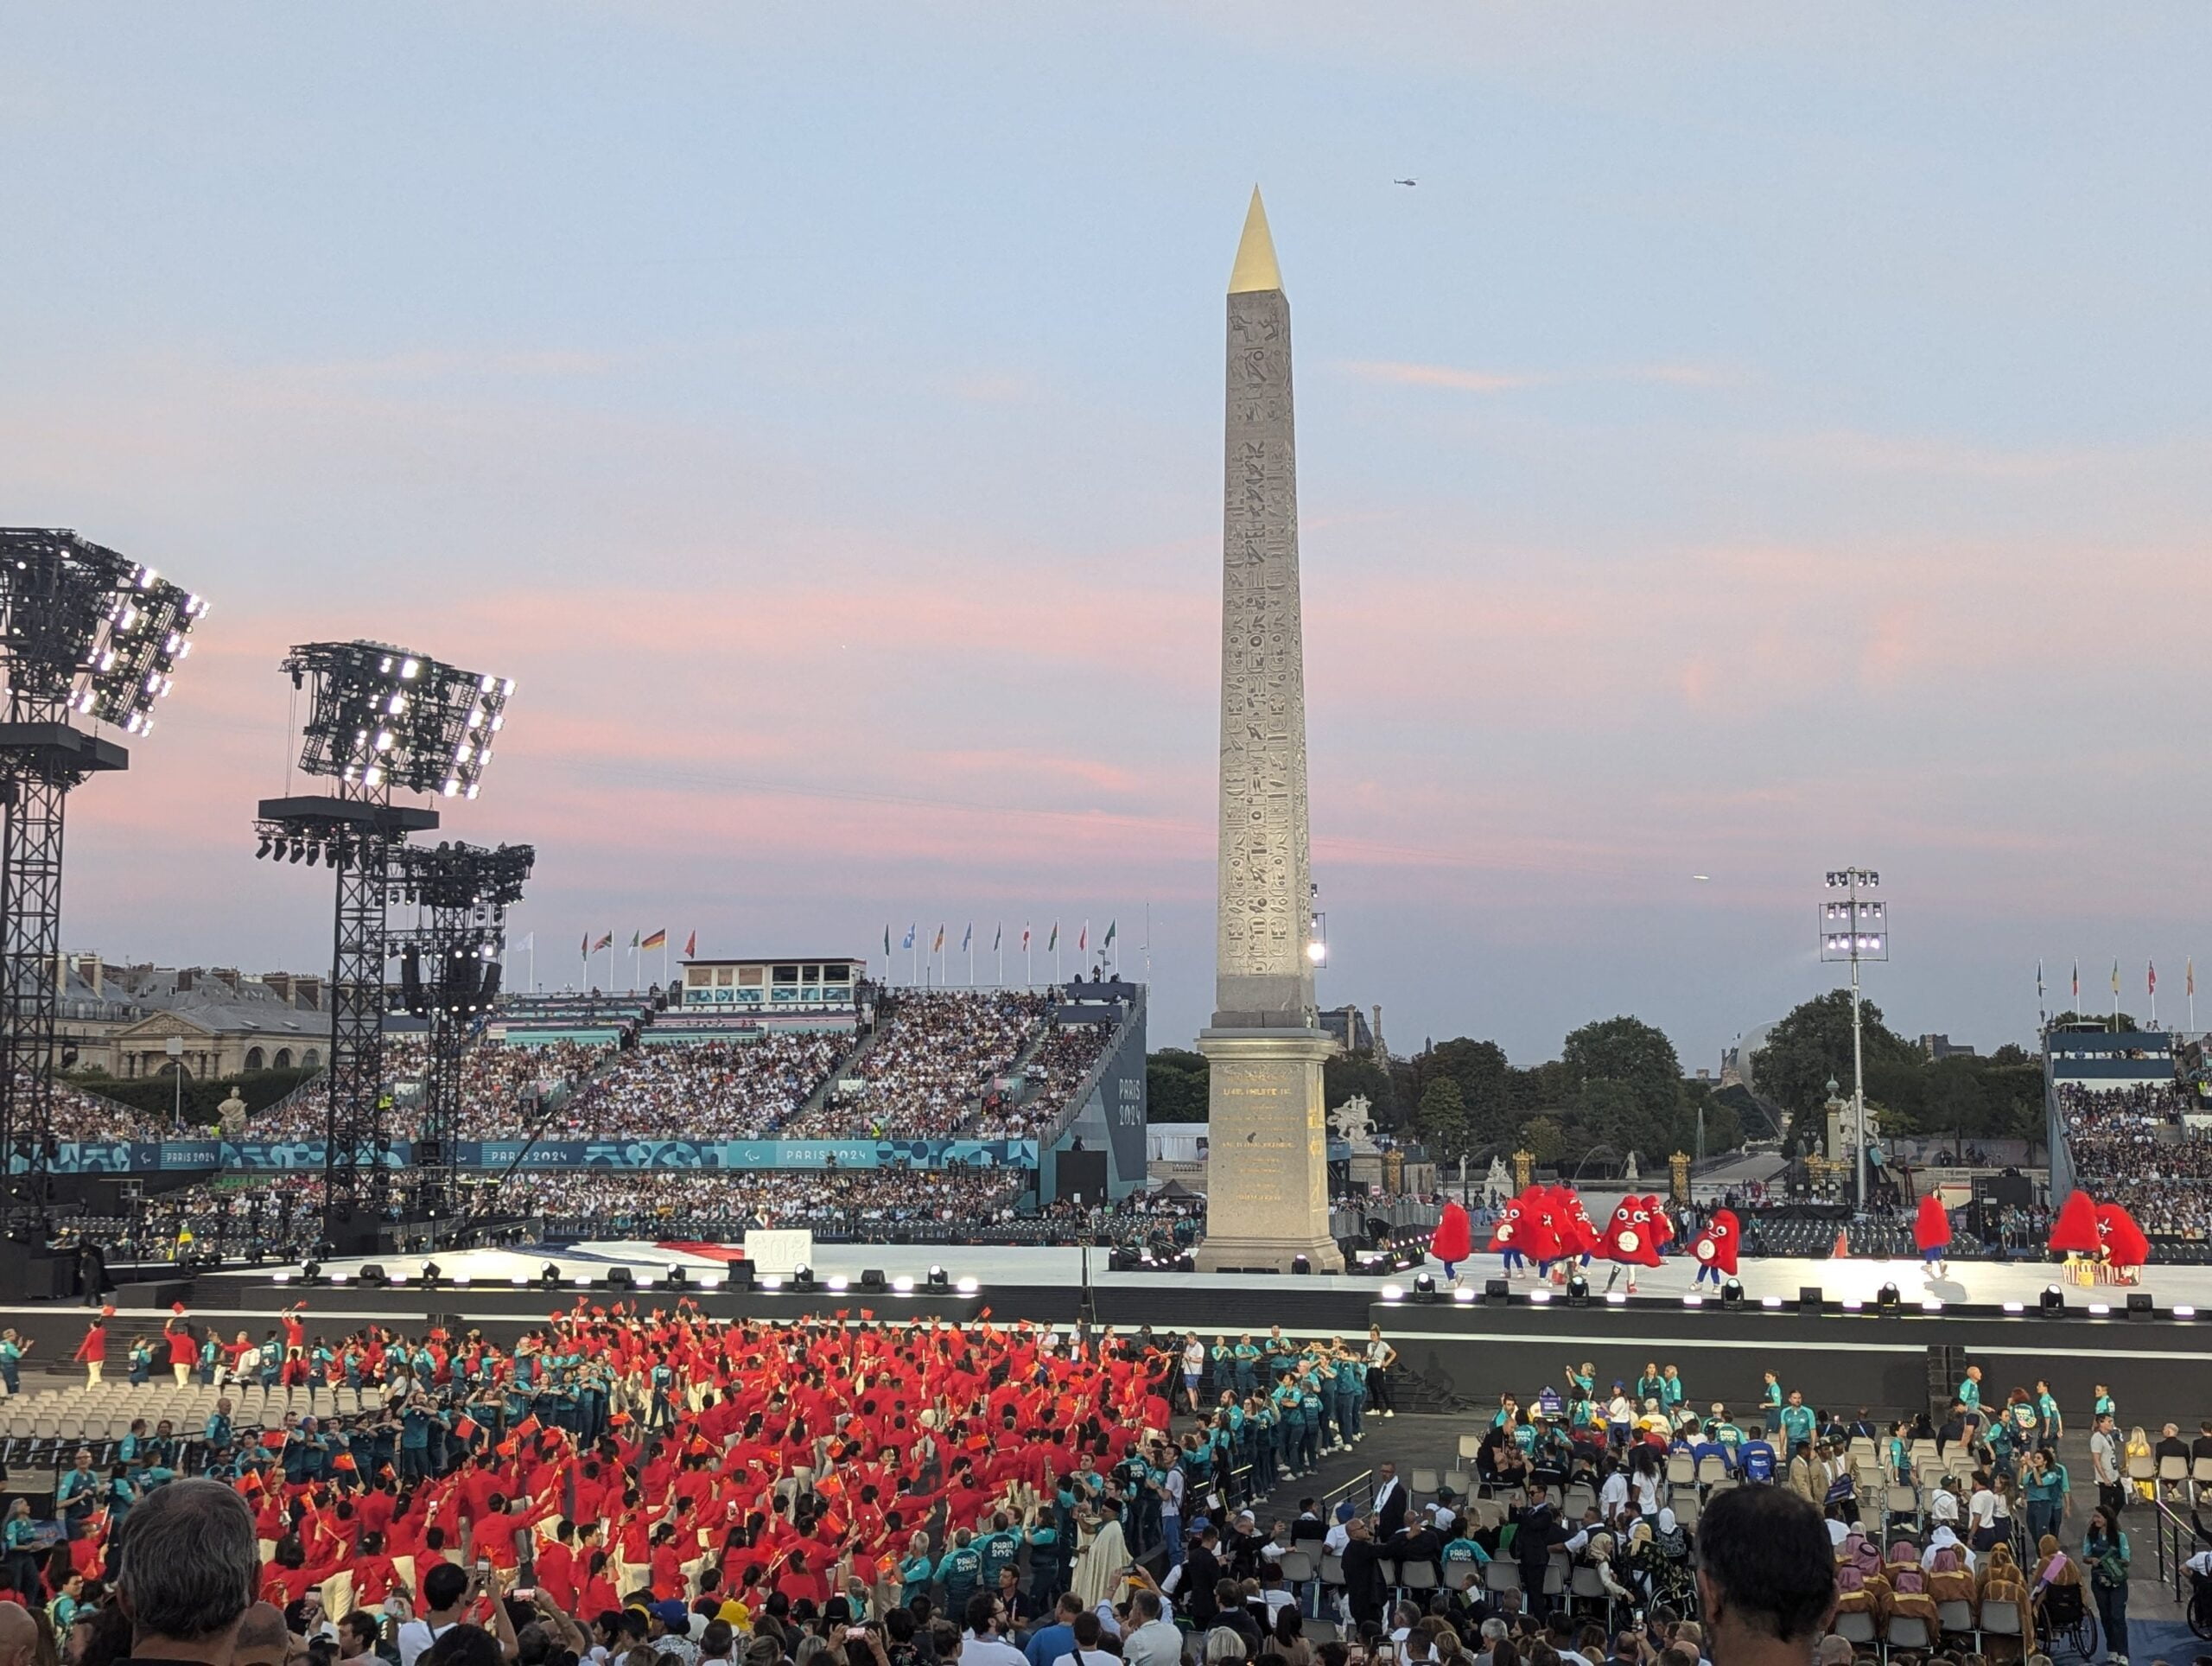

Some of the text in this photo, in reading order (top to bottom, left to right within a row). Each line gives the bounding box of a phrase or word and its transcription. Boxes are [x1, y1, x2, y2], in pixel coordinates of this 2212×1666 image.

[1119, 1104, 1141, 1126] 2024
[193, 1152, 215, 1162] 2024
[491, 1151, 567, 1161] PARS 2024
[785, 1150, 825, 1160] PARIS
[992, 1541, 1014, 1549] PARIS
[991, 1548, 1014, 1557] 2024
